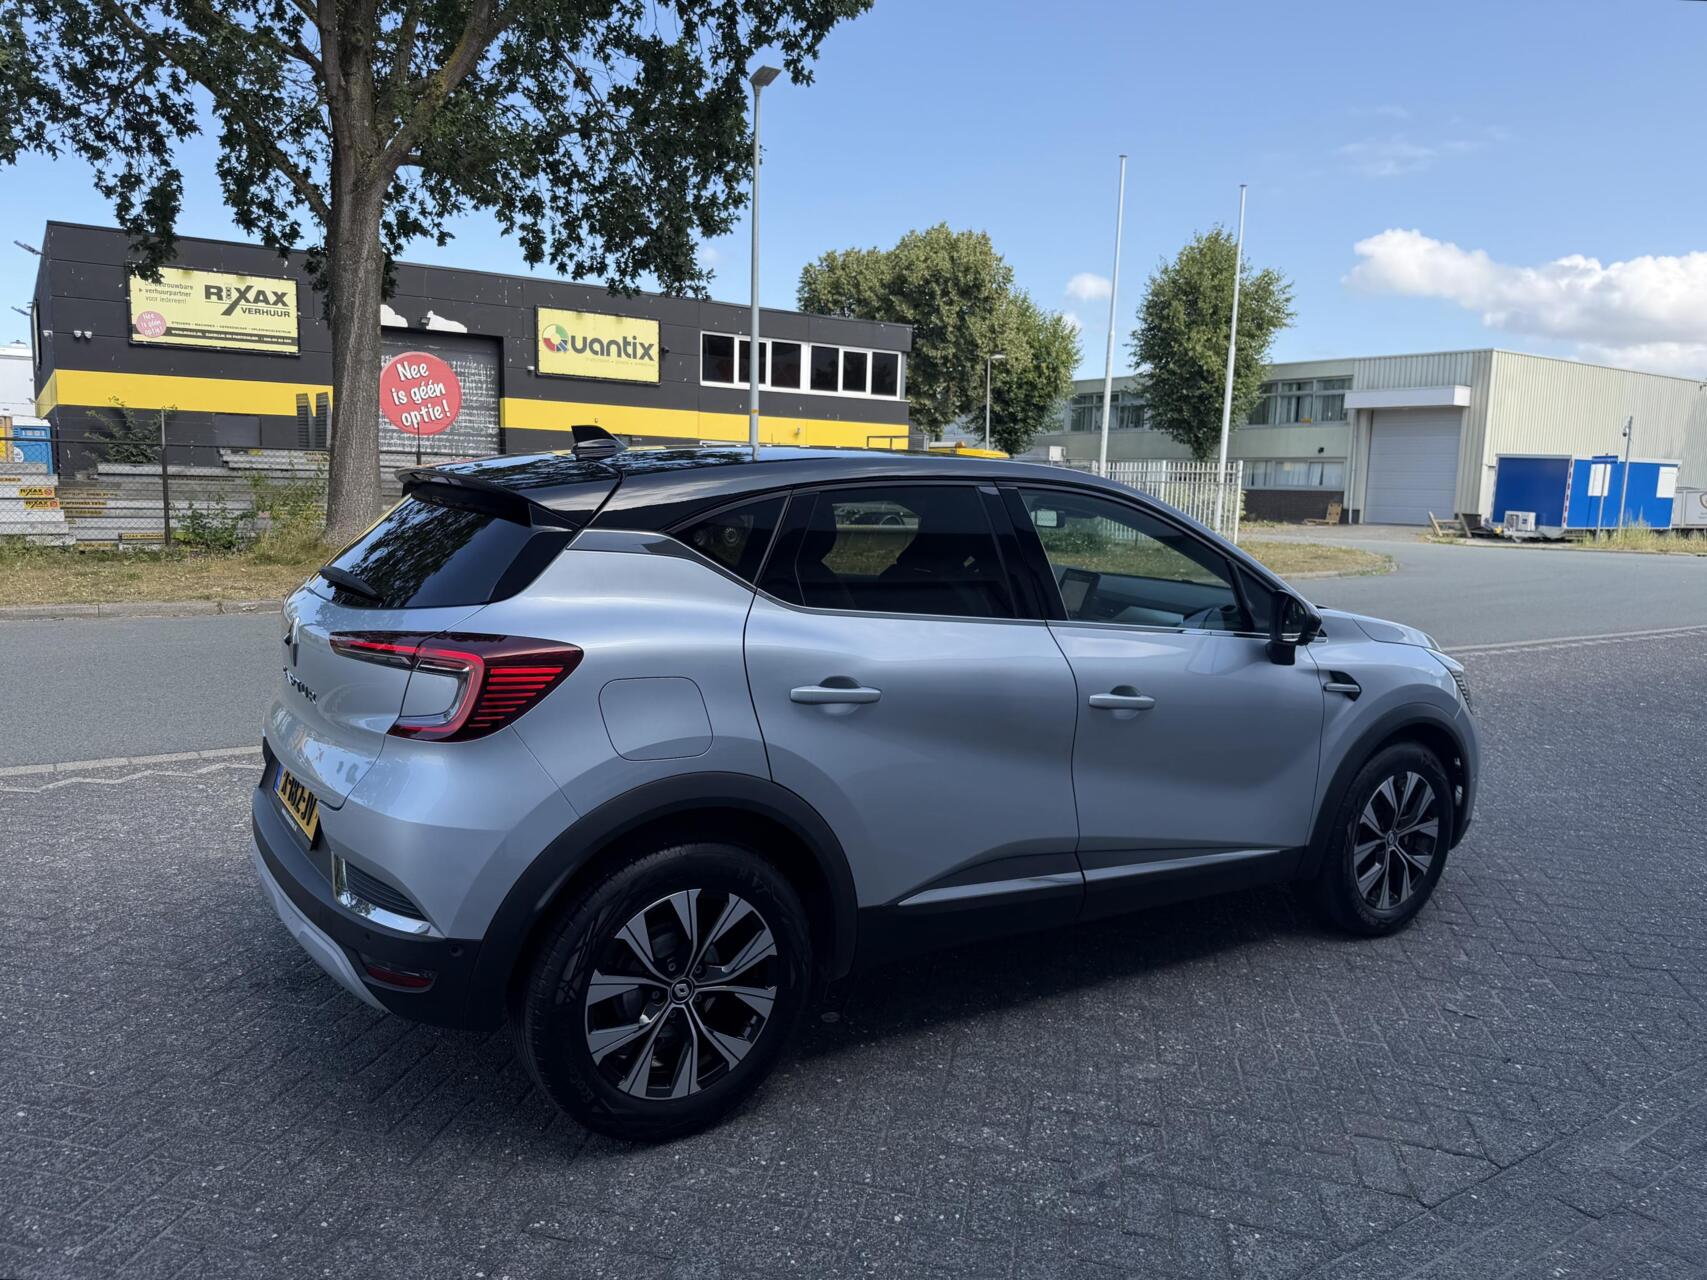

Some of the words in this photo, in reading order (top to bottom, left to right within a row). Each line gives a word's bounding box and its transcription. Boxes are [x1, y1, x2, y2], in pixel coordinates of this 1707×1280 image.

[241, 307, 291, 318] VERHUUR
[395, 361, 429, 381] Nee
[391, 387, 408, 405] is
[410, 379, 446, 404] géén
[401, 399, 451, 429] optie!
